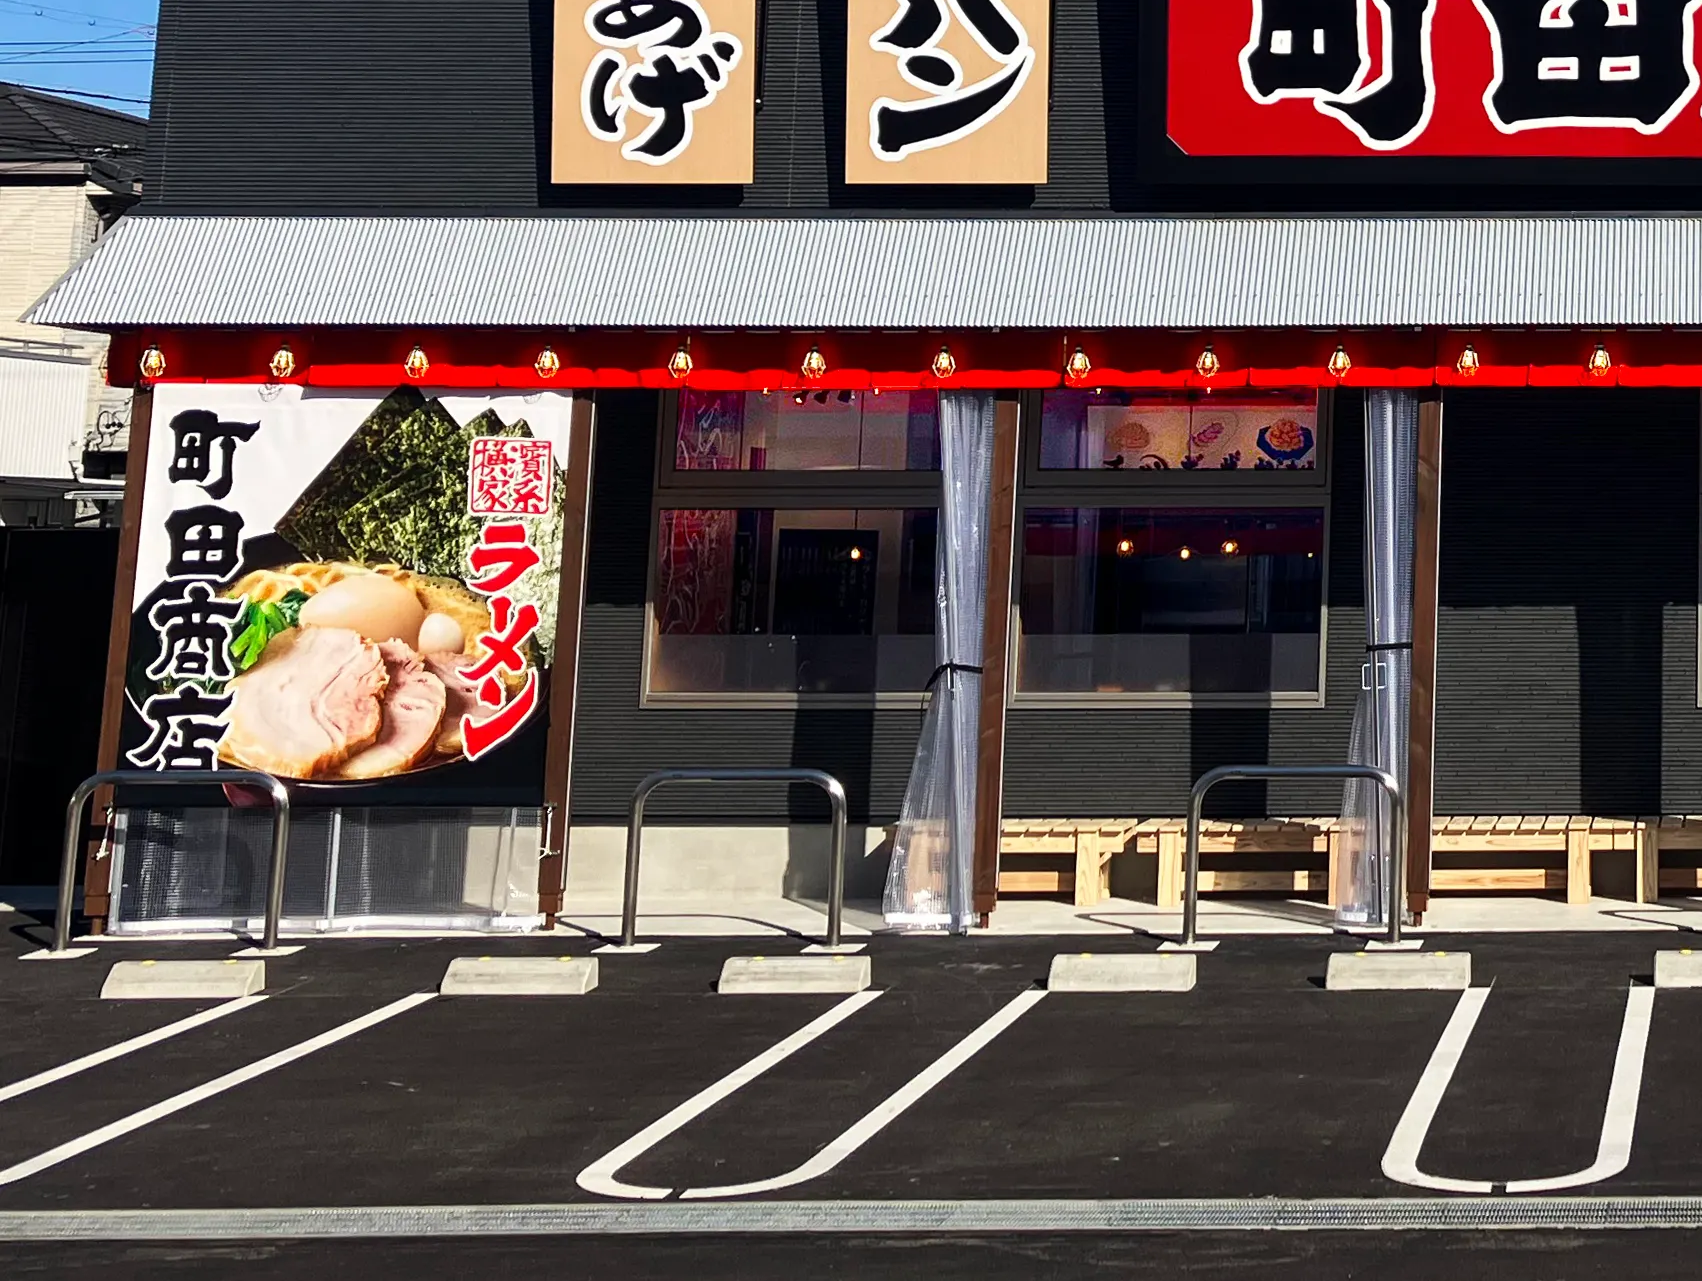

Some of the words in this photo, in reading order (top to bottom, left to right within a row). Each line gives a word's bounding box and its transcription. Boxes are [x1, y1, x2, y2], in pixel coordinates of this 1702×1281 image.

[126, 409, 260, 771] 町田商店
[461, 523, 542, 762] ラーメン
